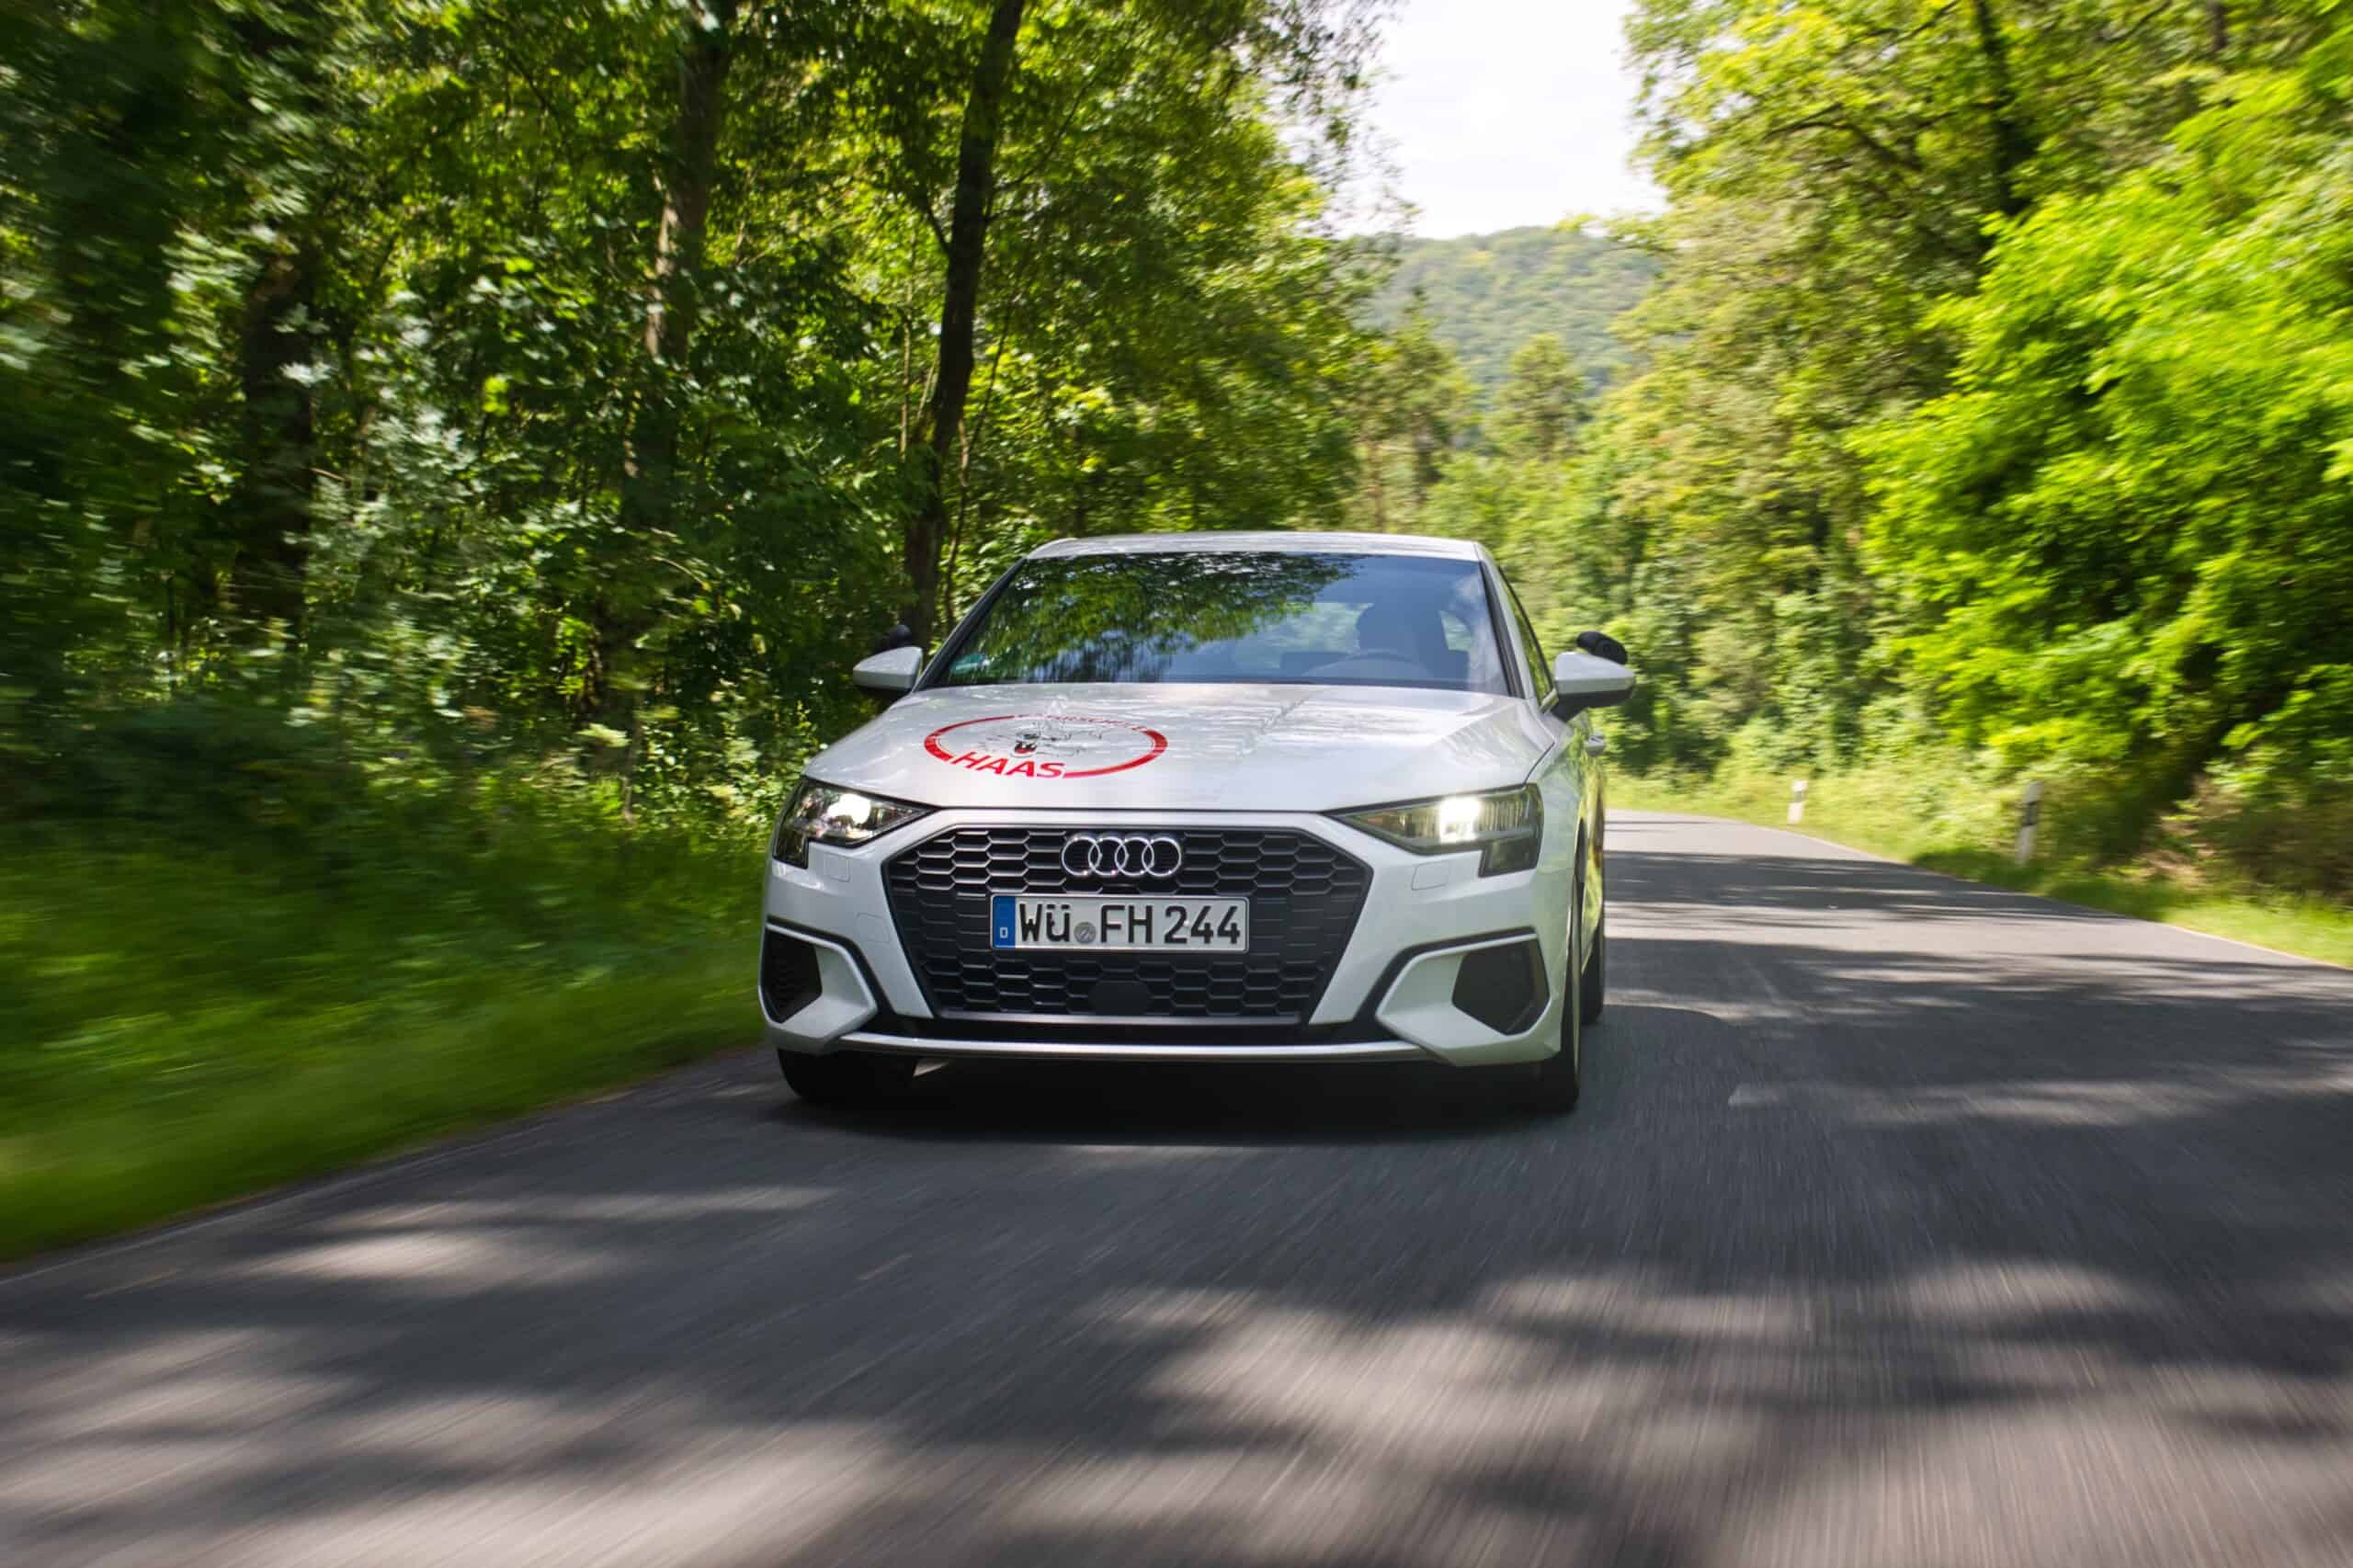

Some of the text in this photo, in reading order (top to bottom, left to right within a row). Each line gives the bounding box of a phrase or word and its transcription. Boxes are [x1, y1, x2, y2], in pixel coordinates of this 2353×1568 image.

[950, 751, 1065, 778] HAAS
[1100, 904, 1153, 944] FH
[1164, 905, 1241, 945] 244
